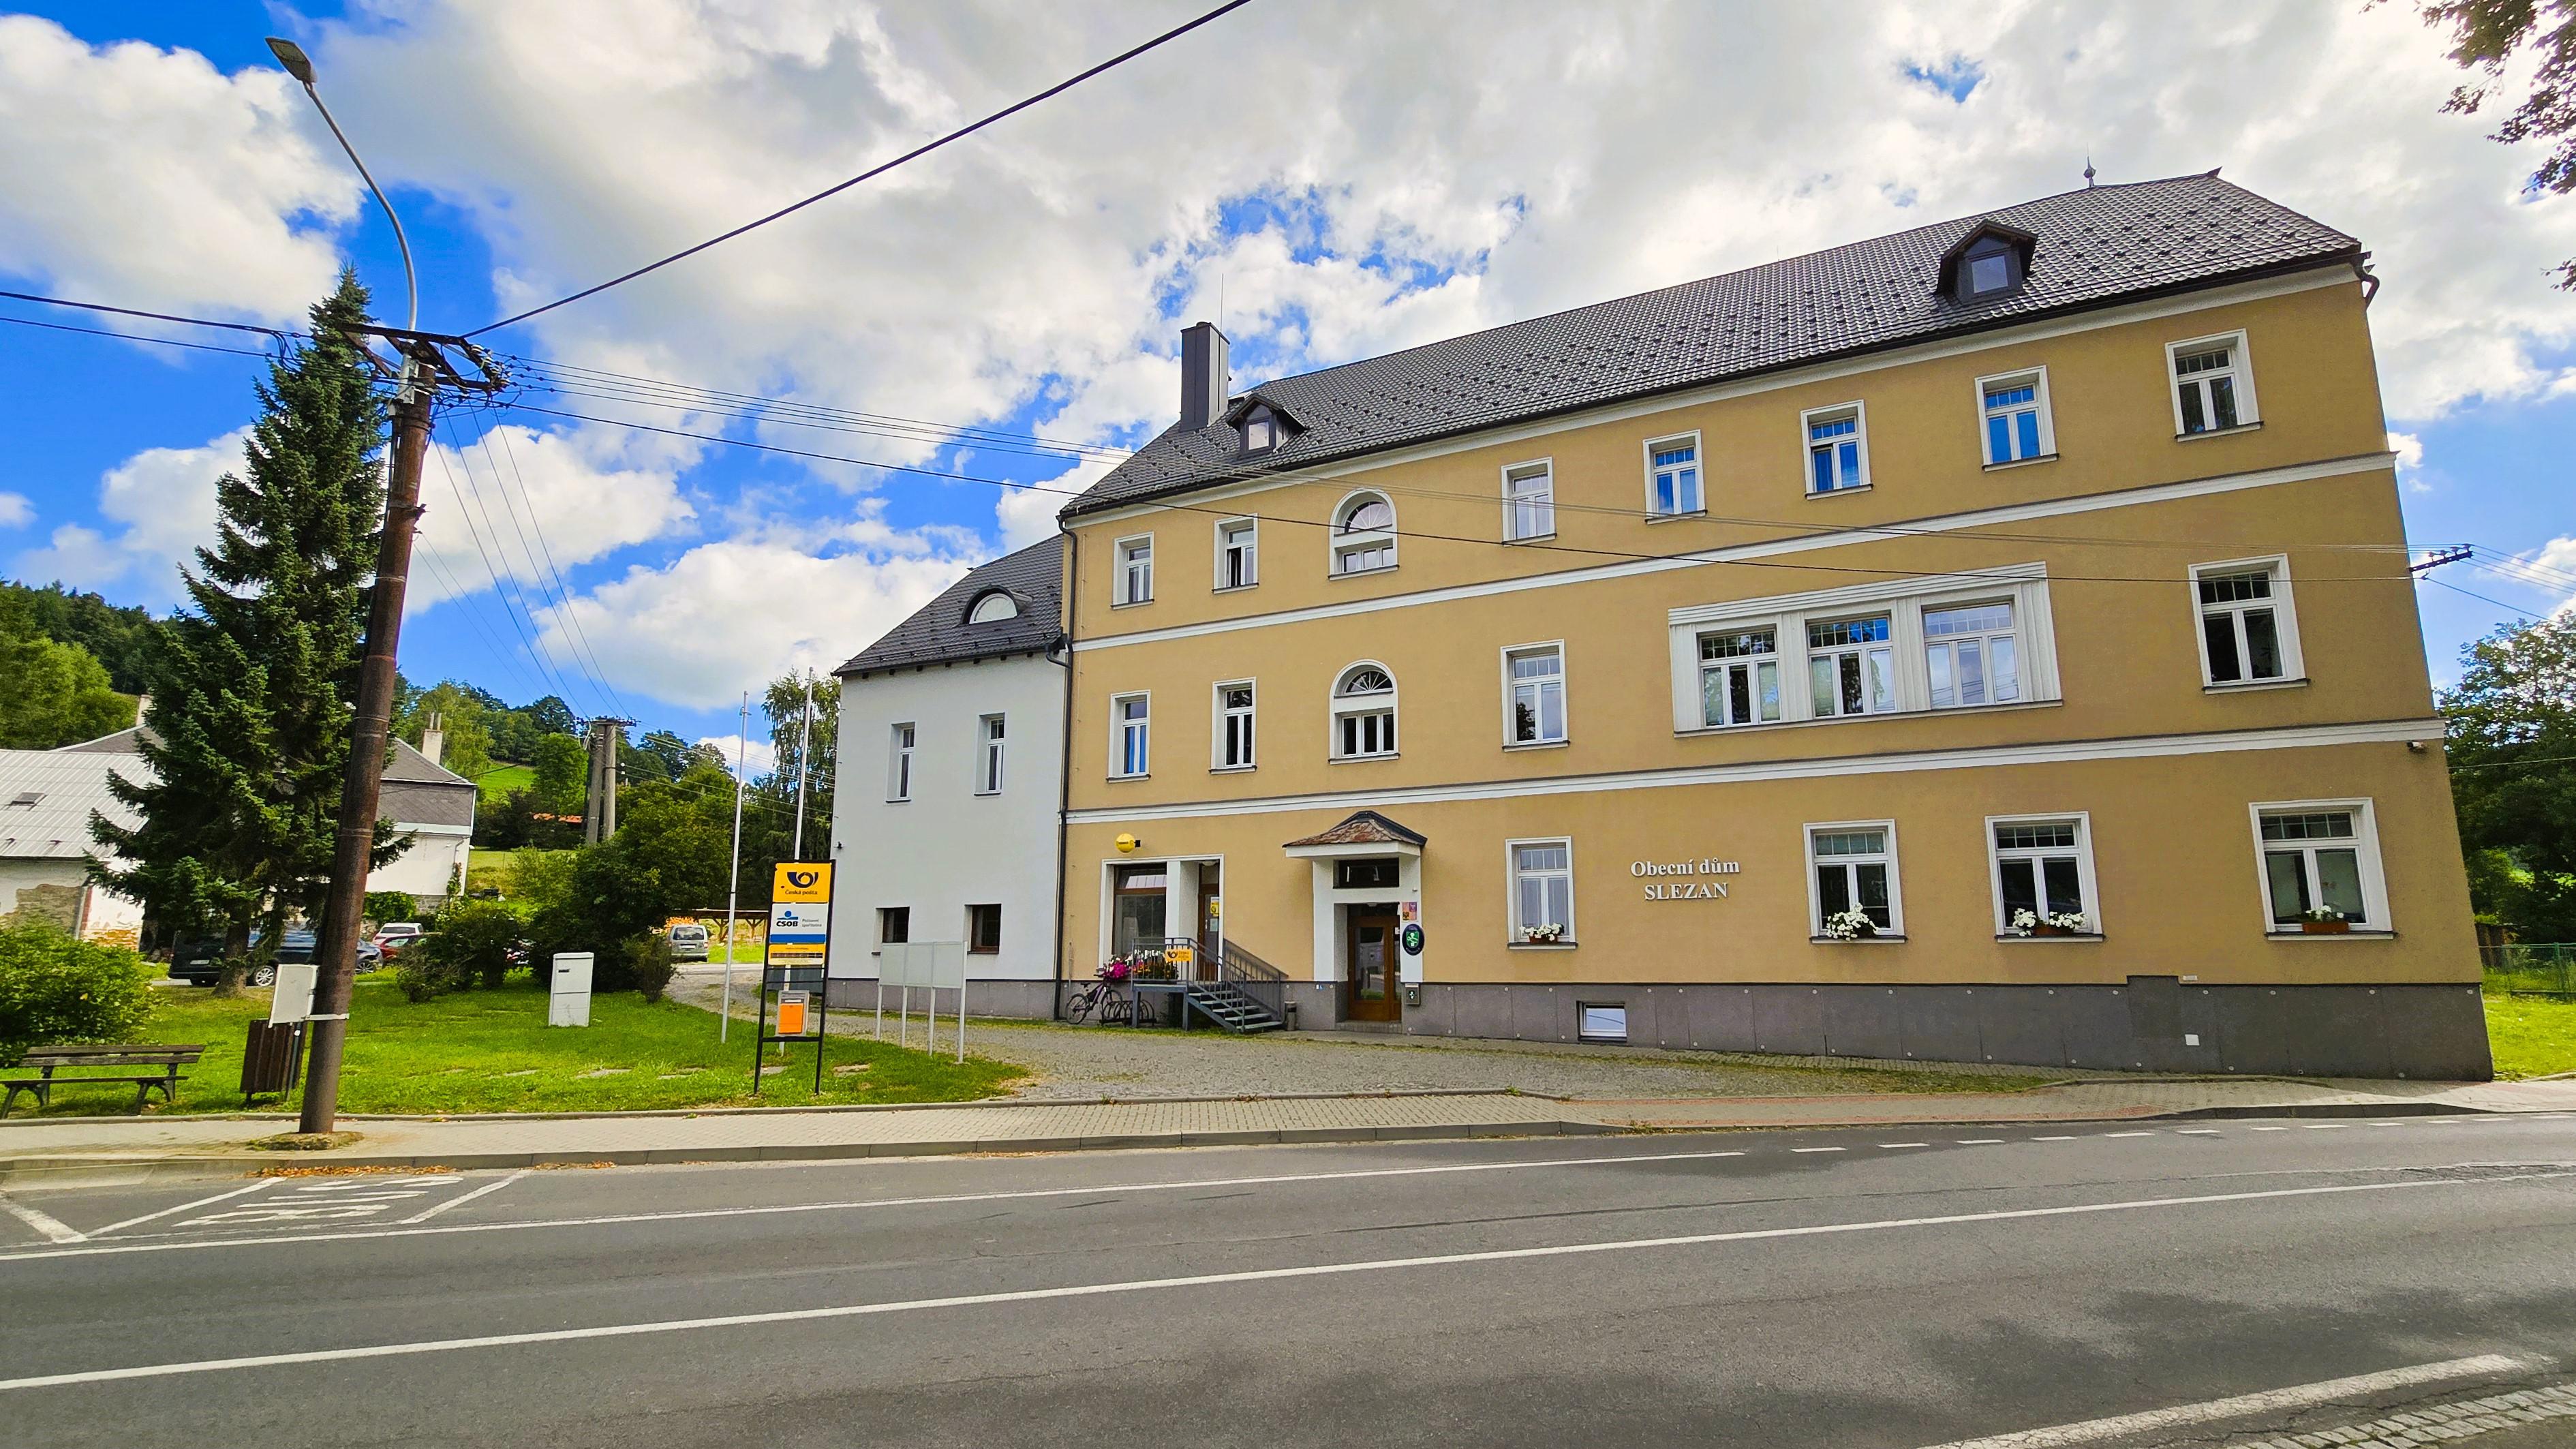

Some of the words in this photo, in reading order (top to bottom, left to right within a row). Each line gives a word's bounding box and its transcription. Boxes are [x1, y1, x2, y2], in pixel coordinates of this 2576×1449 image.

[1630, 858, 1694, 877] Obecní
[1699, 857, 1740, 874] dům
[1644, 883, 1728, 900] SLEZAN
